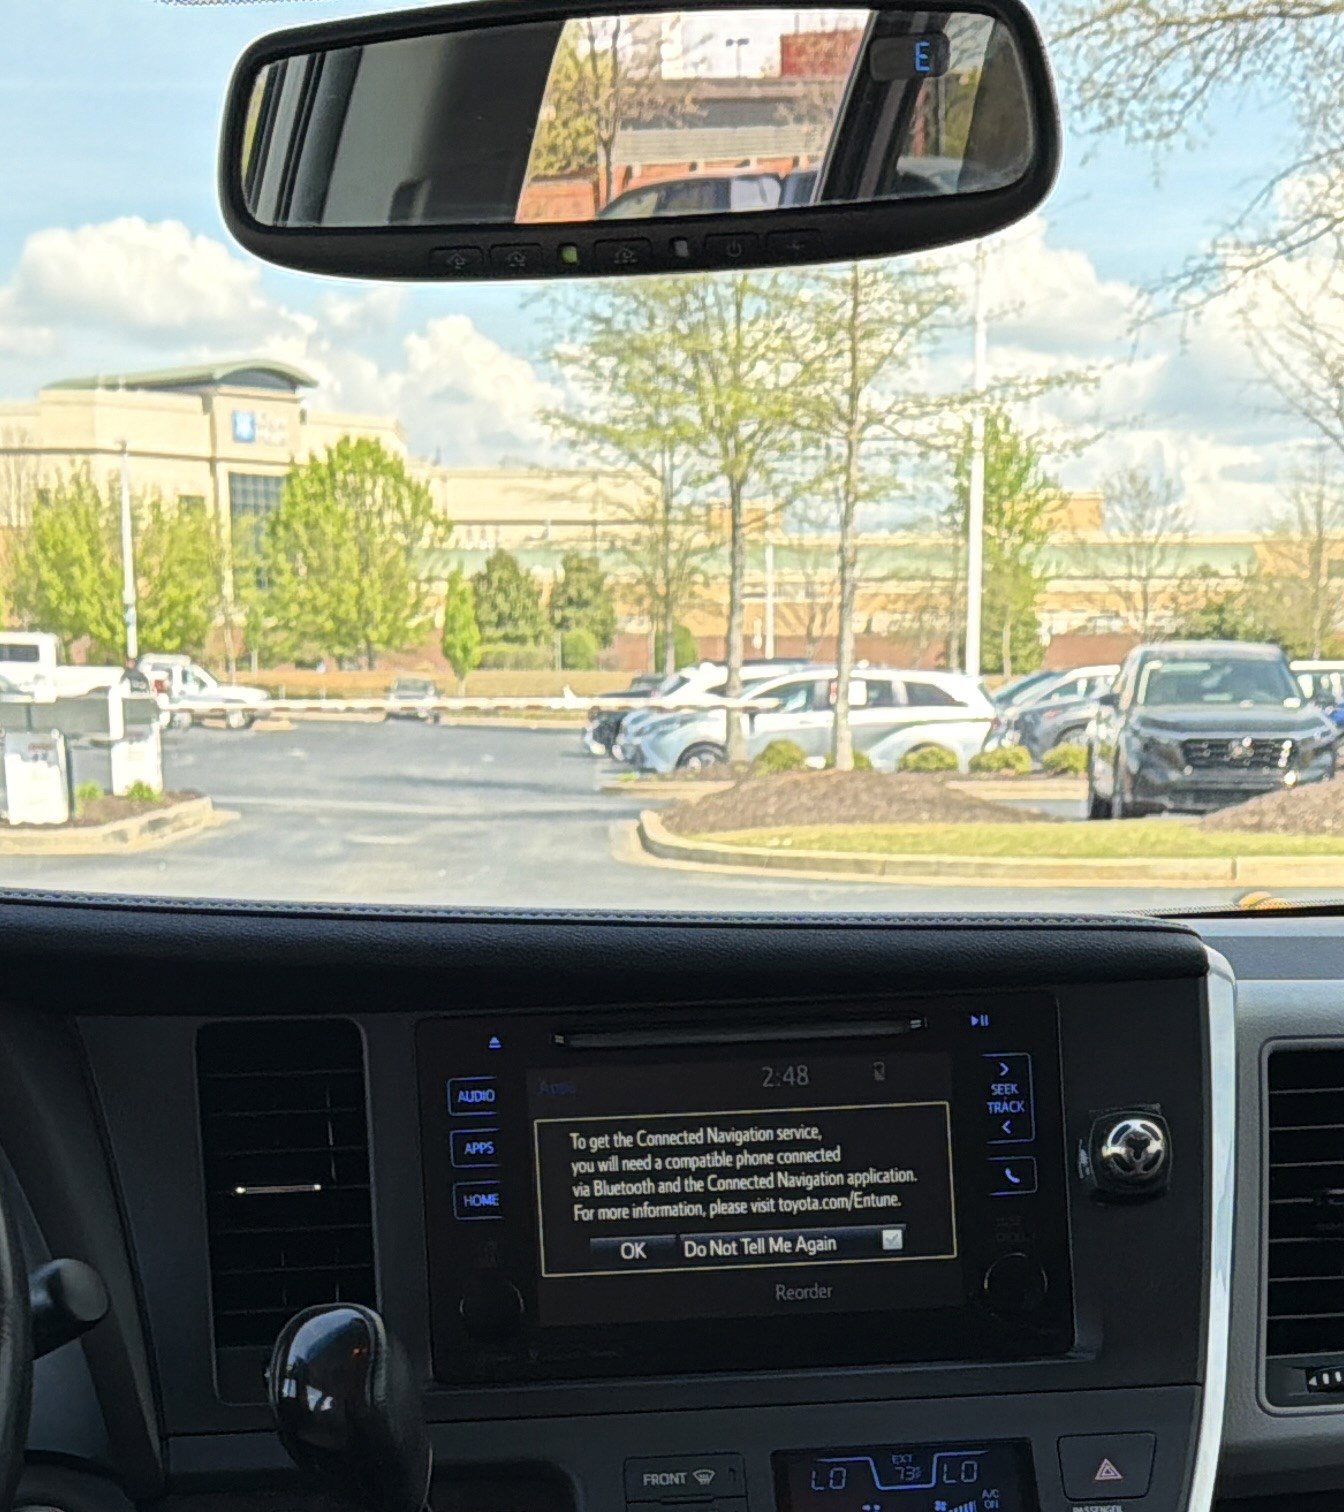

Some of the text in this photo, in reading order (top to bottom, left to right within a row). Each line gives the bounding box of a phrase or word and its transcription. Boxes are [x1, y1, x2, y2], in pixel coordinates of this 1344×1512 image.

[916, 40, 930, 73] E
[762, 1064, 809, 1087] 2:48
[458, 1088, 496, 1103] AUDIO
[990, 1083, 1019, 1096] SEEK
[986, 1100, 1025, 1114] TRACK
[570, 1124, 822, 1153] To get the Connected Navigation service,
[464, 1140, 495, 1155] APPS
[571, 1145, 842, 1177] you will need a compatible phone connected
[572, 1167, 918, 1197] via Bluetooth and the Connected Navigation application.
[463, 1193, 500, 1207] HOME
[573, 1190, 902, 1221] For more information, please visit toyota.com/Entune.
[621, 1242, 647, 1259] OK
[684, 1235, 837, 1257] Do Not Tell Me Again
[775, 1283, 833, 1300] Reorder
[891, 1454, 913, 1465] EXT
[643, 1472, 687, 1486] FRONT
[811, 1467, 846, 1490] LO
[943, 1460, 978, 1484] LO
[982, 1489, 999, 1499] A/C
